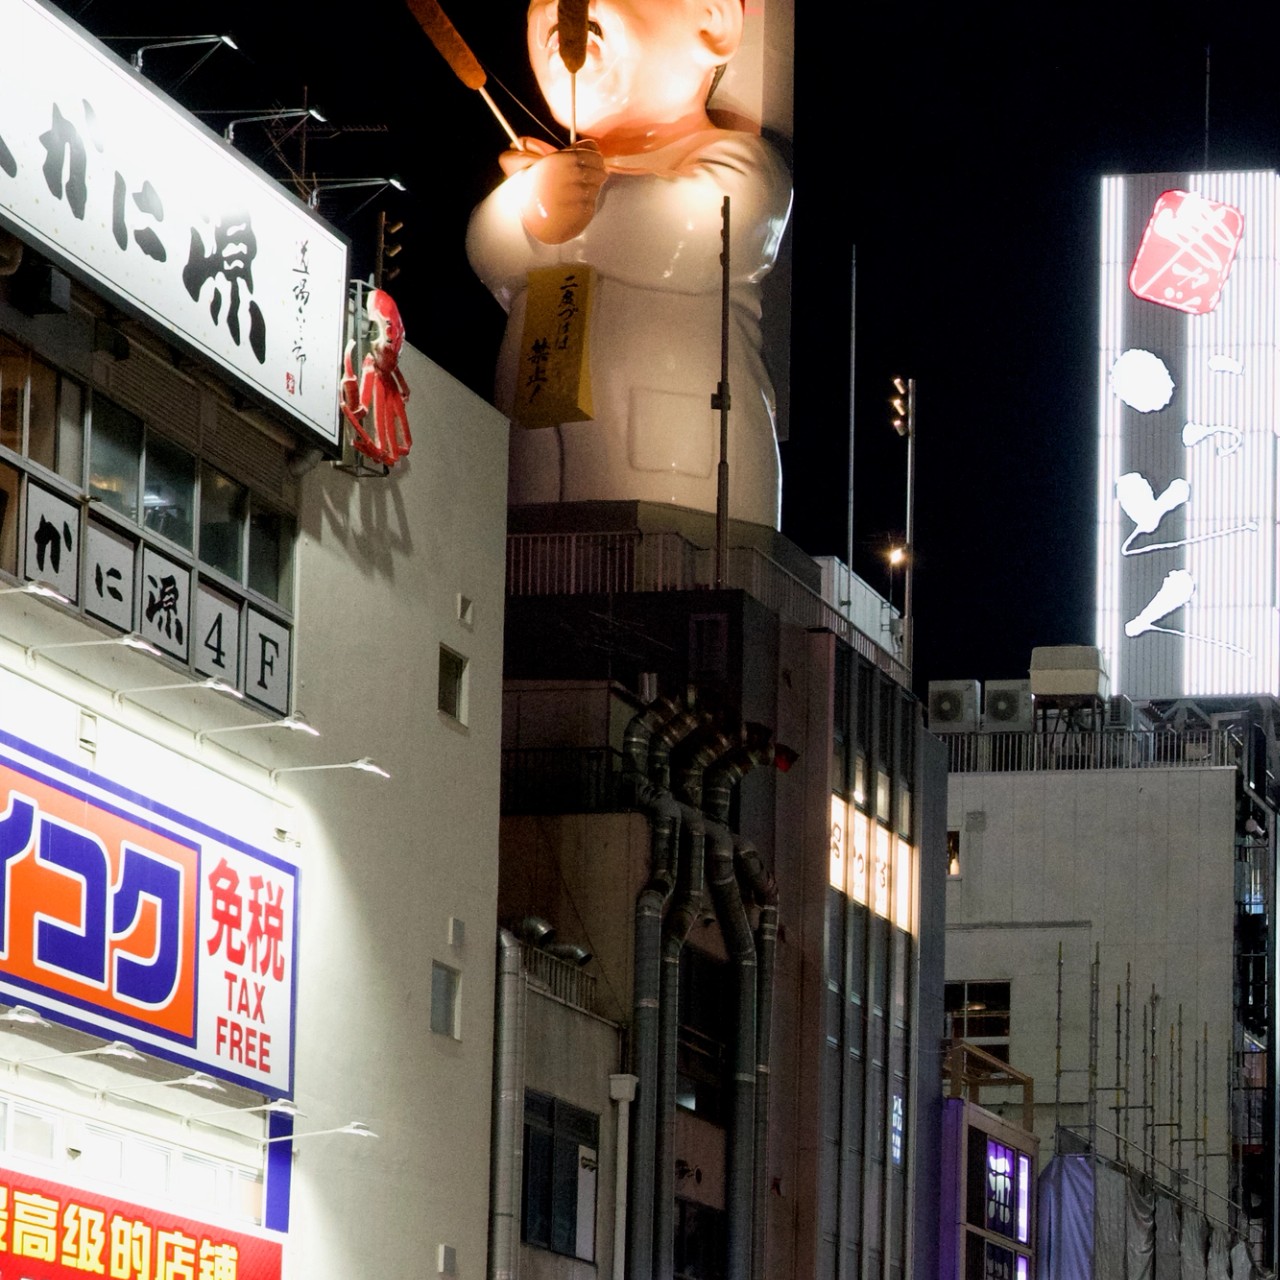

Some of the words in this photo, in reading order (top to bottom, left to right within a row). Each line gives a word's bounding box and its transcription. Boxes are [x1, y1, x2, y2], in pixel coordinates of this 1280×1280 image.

[0, 98, 267, 366] かに源
[206, 857, 286, 983] 免税
[223, 970, 267, 1025] TAX
[215, 1015, 273, 1075] FREE
